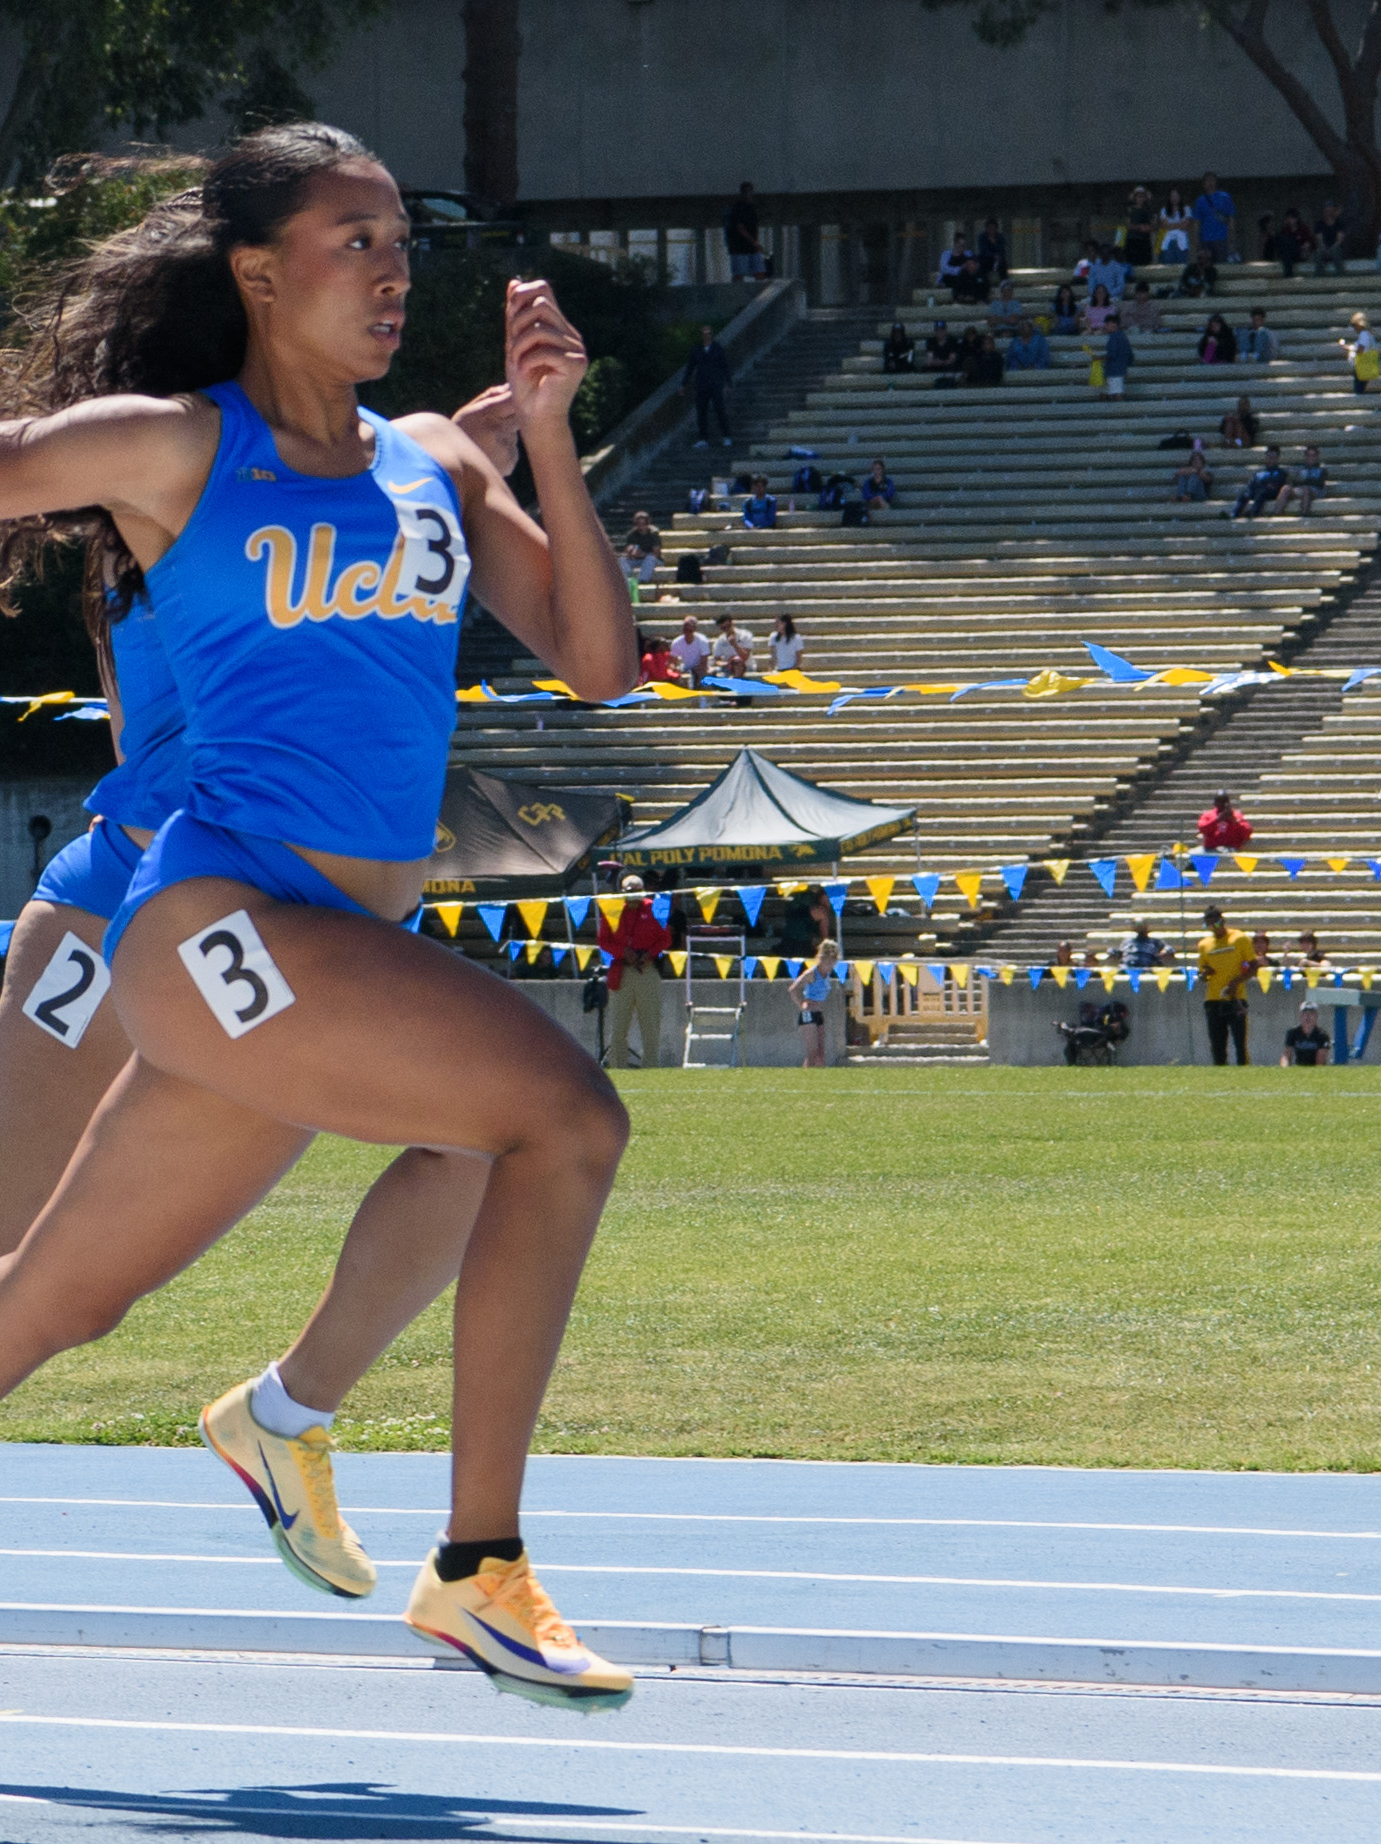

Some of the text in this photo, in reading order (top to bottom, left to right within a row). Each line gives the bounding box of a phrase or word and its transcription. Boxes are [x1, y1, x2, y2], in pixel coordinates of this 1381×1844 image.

[415, 509, 455, 594] 3
[651, 848, 694, 865] POLY
[699, 846, 783, 862] POMONA
[34, 949, 95, 1036] 2
[199, 930, 269, 1023] 3
